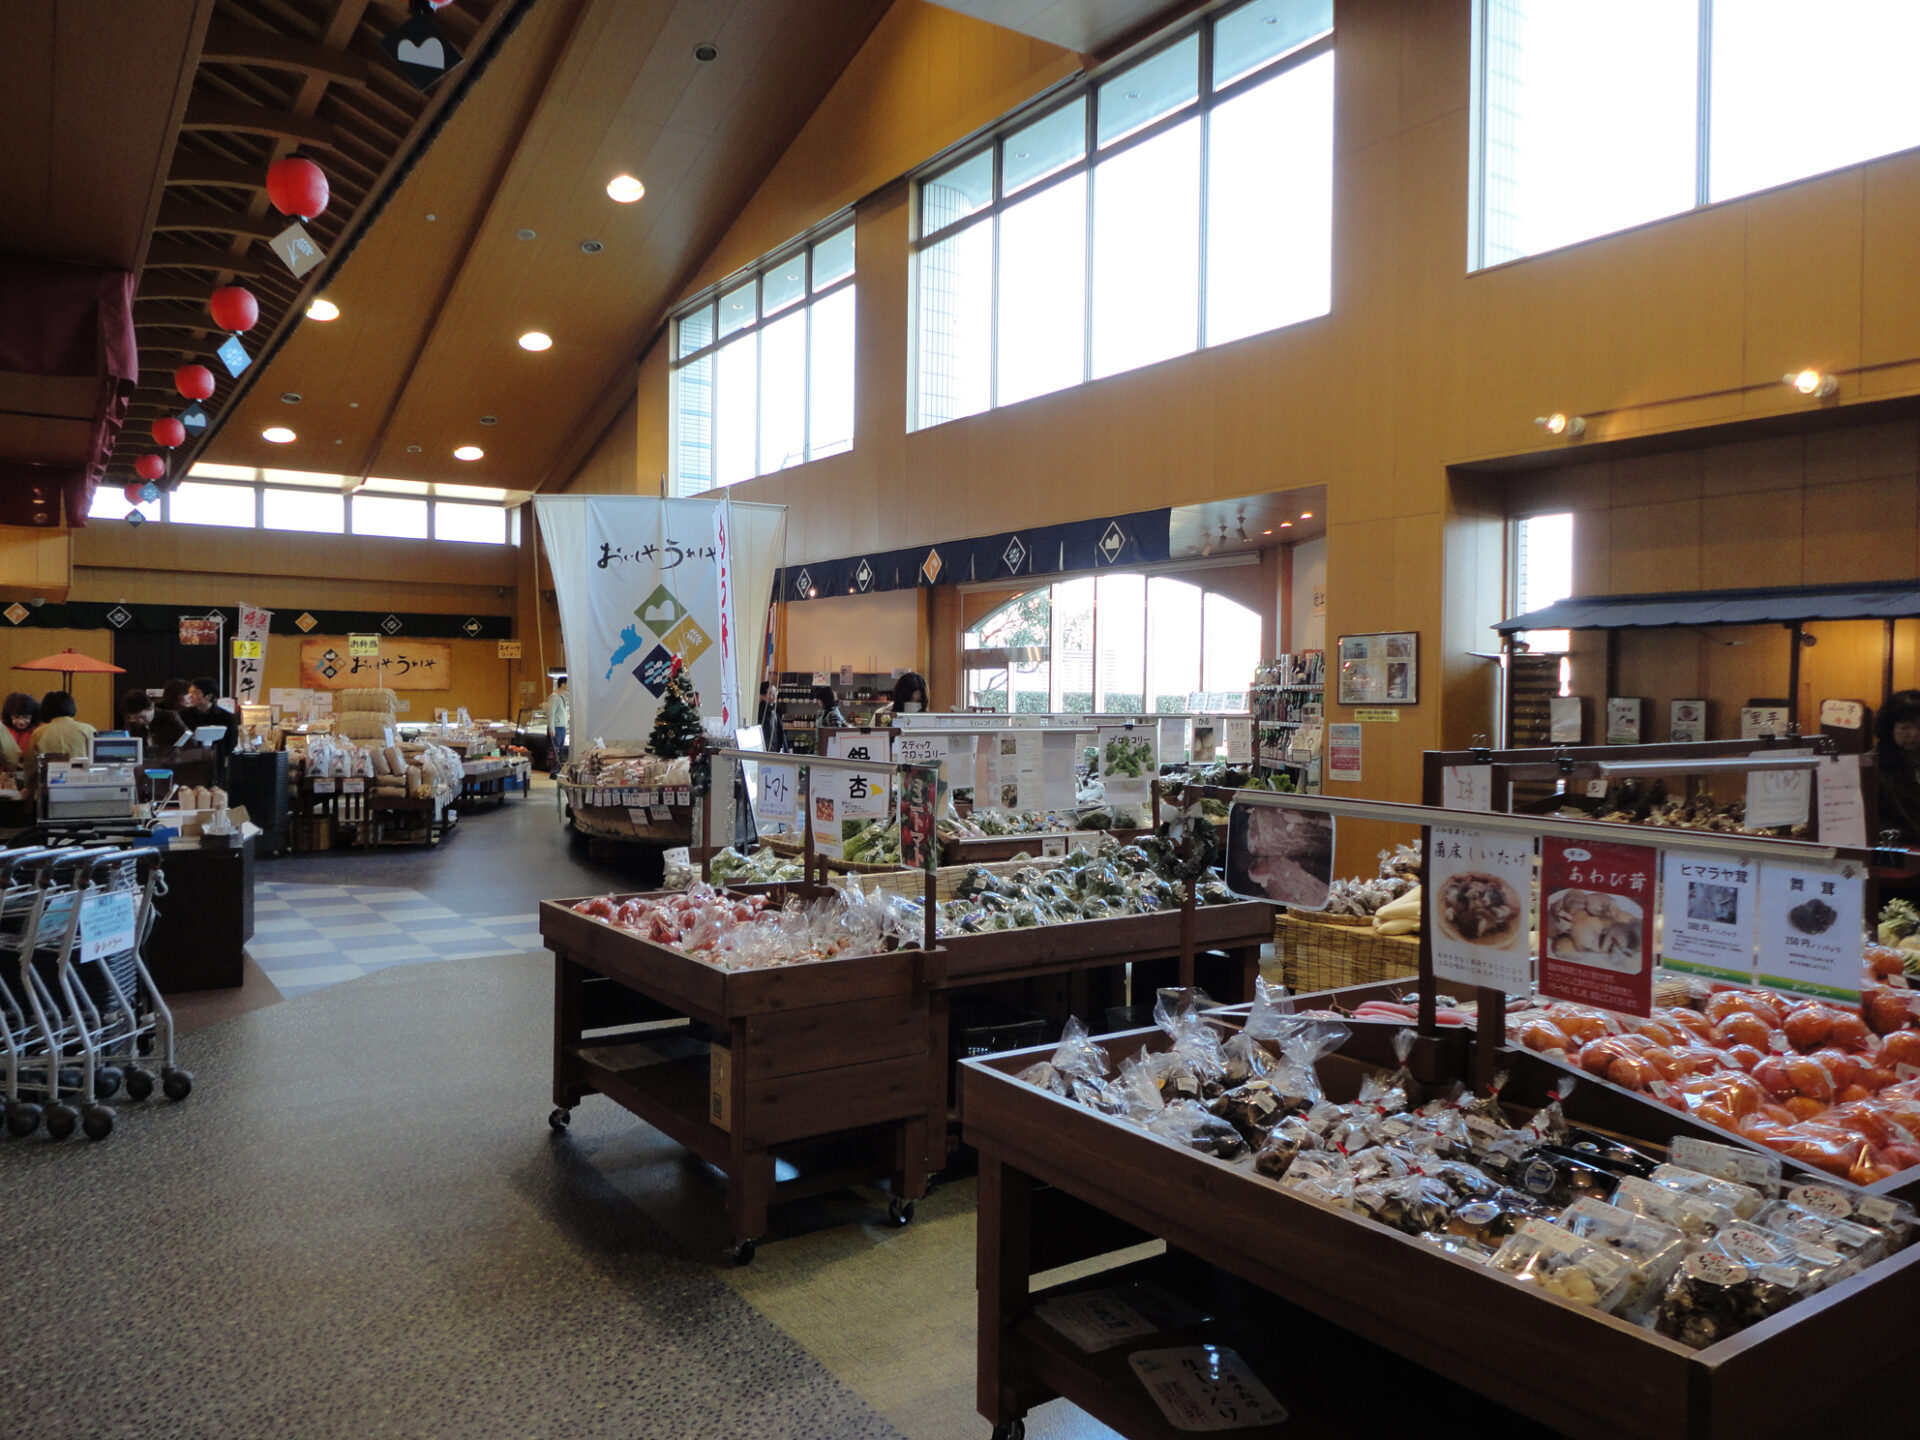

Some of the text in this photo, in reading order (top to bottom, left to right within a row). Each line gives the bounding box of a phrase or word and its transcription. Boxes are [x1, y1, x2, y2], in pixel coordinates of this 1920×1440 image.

[350, 639, 378, 649] お弁当
[901, 740, 931, 750] スティック
[764, 773, 789, 803] トマト
[909, 778, 925, 867] ミニトマト
[1434, 840, 1527, 867] 菌床しいたけ
[1569, 865, 1648, 893] あわび茸
[1681, 863, 1749, 884] ヒマラヤ茸
